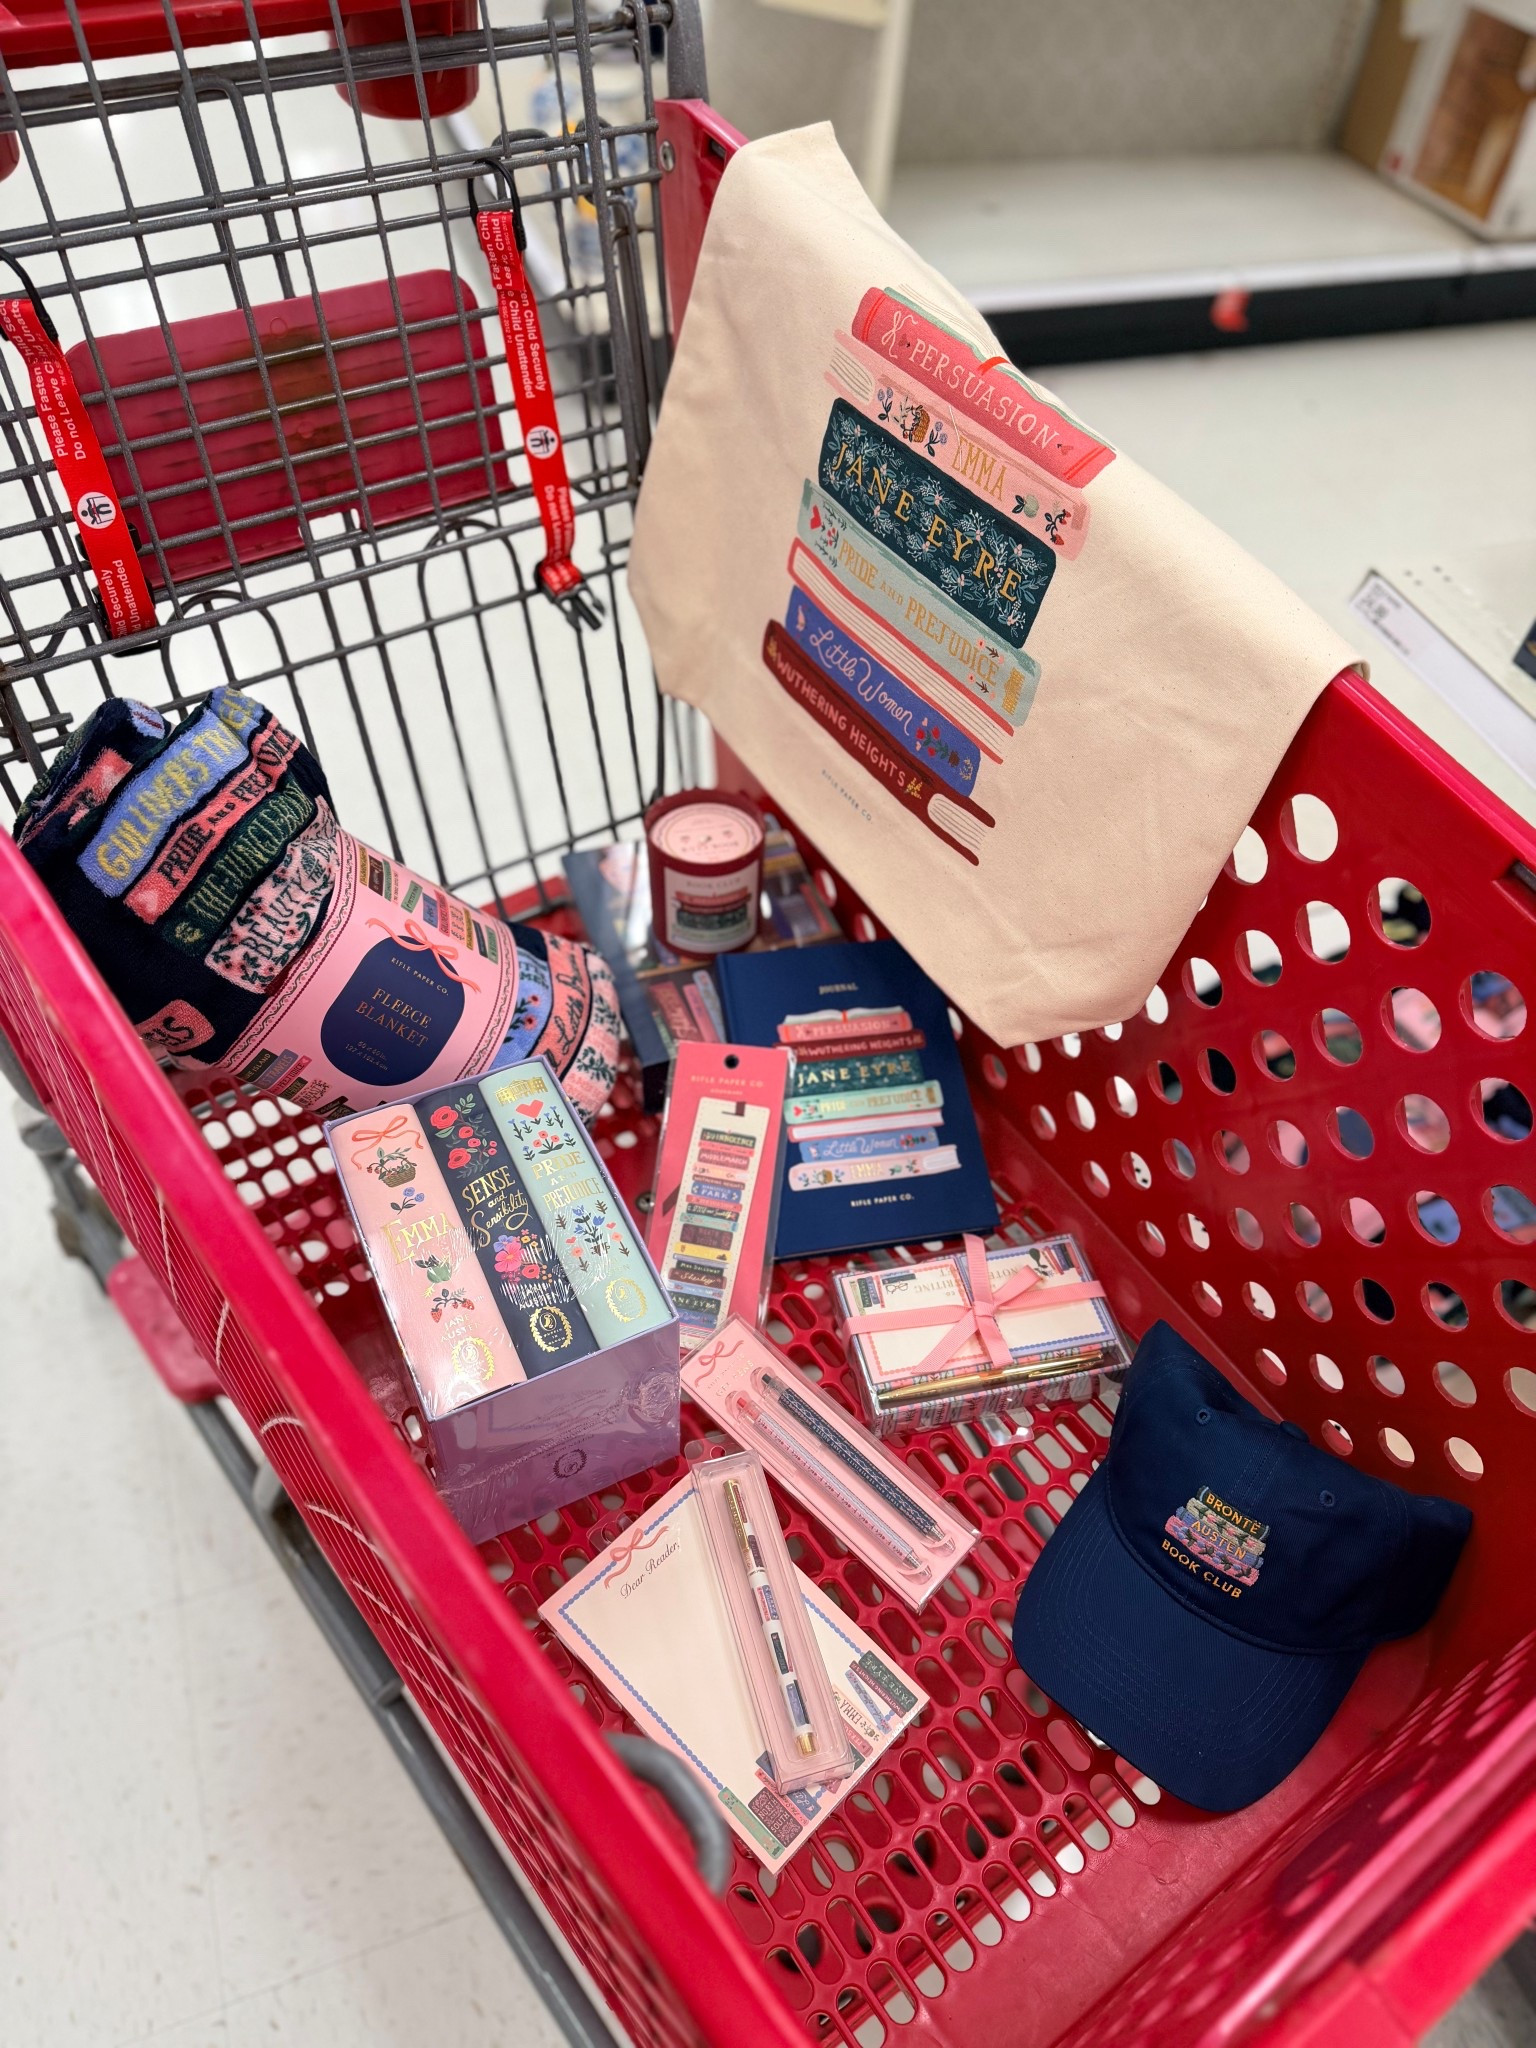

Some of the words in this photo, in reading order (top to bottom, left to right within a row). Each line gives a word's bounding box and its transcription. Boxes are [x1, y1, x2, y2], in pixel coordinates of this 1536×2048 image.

[491, 218, 505, 251] Child
[509, 300, 522, 331] Child
[524, 310, 538, 340] Child
[515, 334, 535, 399] Unattended
[530, 343, 547, 391] Securely
[34, 367, 52, 412] Fasten
[50, 378, 70, 416] Leave
[911, 337, 1060, 451] PERSUASION
[48, 414, 69, 457] Please
[64, 418, 80, 439] not
[74, 441, 86, 460] Do
[950, 433, 1006, 502] EMMA
[544, 484, 554, 501] Do
[548, 501, 560, 521] not
[832, 444, 915, 522] JANE
[927, 514, 1023, 603] EYRE
[101, 569, 123, 619] Securely
[113, 559, 141, 624] Unattended
[838, 539, 876, 591] PRIDE
[880, 581, 905, 606] AND
[905, 596, 1001, 687] PREJUDICE
[809, 627, 858, 682] Little
[856, 656, 914, 736] Women
[775, 658, 848, 731] WUTHERING
[850, 724, 908, 787] HEIGHTS
[820, 768, 838, 789] RIFLE
[840, 789, 861, 811] PAPER
[97, 748, 214, 880] GULLIVERS
[157, 824, 217, 888] PRIDE
[246, 874, 304, 960] BEAUTY
[391, 957, 411, 973] RIFLE
[413, 970, 435, 987] PAPER
[436, 984, 449, 996] CO.
[818, 982, 859, 996] JOURNAL
[355, 1000, 429, 1047] BLANKET
[371, 987, 432, 1029] FLEECE
[812, 1019, 891, 1038] PERSUASION
[807, 1039, 869, 1057] WUTHERING
[869, 1035, 913, 1051] HEIGHTS
[253, 1053, 271, 1074] ISLAND
[265, 1055, 294, 1083] TRAVELS
[278, 1061, 306, 1090] PREJUDICE
[797, 1066, 851, 1088] JANE
[859, 1060, 912, 1079] EYRE
[690, 1075, 715, 1084] RIFLE
[718, 1077, 747, 1087] PAPER
[819, 1098, 847, 1113] PRIDE
[822, 1140, 857, 1158] Little
[857, 1136, 900, 1155] Women
[531, 1151, 586, 1181] PRIDE
[850, 1160, 884, 1180] EMMA
[461, 1164, 516, 1213] SENSE
[487, 1191, 508, 1209] and
[543, 1177, 605, 1212] PREJUDICE
[701, 1188, 729, 1200] PARK
[850, 1197, 872, 1208] RIFLE
[874, 1194, 898, 1205] PAPER
[899, 1192, 915, 1202] CO.
[470, 1188, 534, 1248] Sensibility
[380, 1211, 456, 1265] EMMA
[812, 1425, 831, 1443] AUSTEN
[1206, 1492, 1263, 1534] BRONTË
[1191, 1520, 1248, 1560] AUSTEN
[620, 1573, 646, 1599] Dear
[645, 1542, 680, 1575] Reader,
[1161, 1539, 1201, 1574] BOOK
[1203, 1571, 1243, 1599] CLUB
[855, 1665, 877, 1687] HEIGHTS
[864, 1654, 889, 1683] EYRE
[874, 1683, 902, 1714] WUTHERING
[888, 1681, 914, 1705] JANE
[840, 1698, 865, 1726] EMMA
[758, 1798, 778, 1822] NORTH
[770, 1812, 791, 1833] SOUTH
